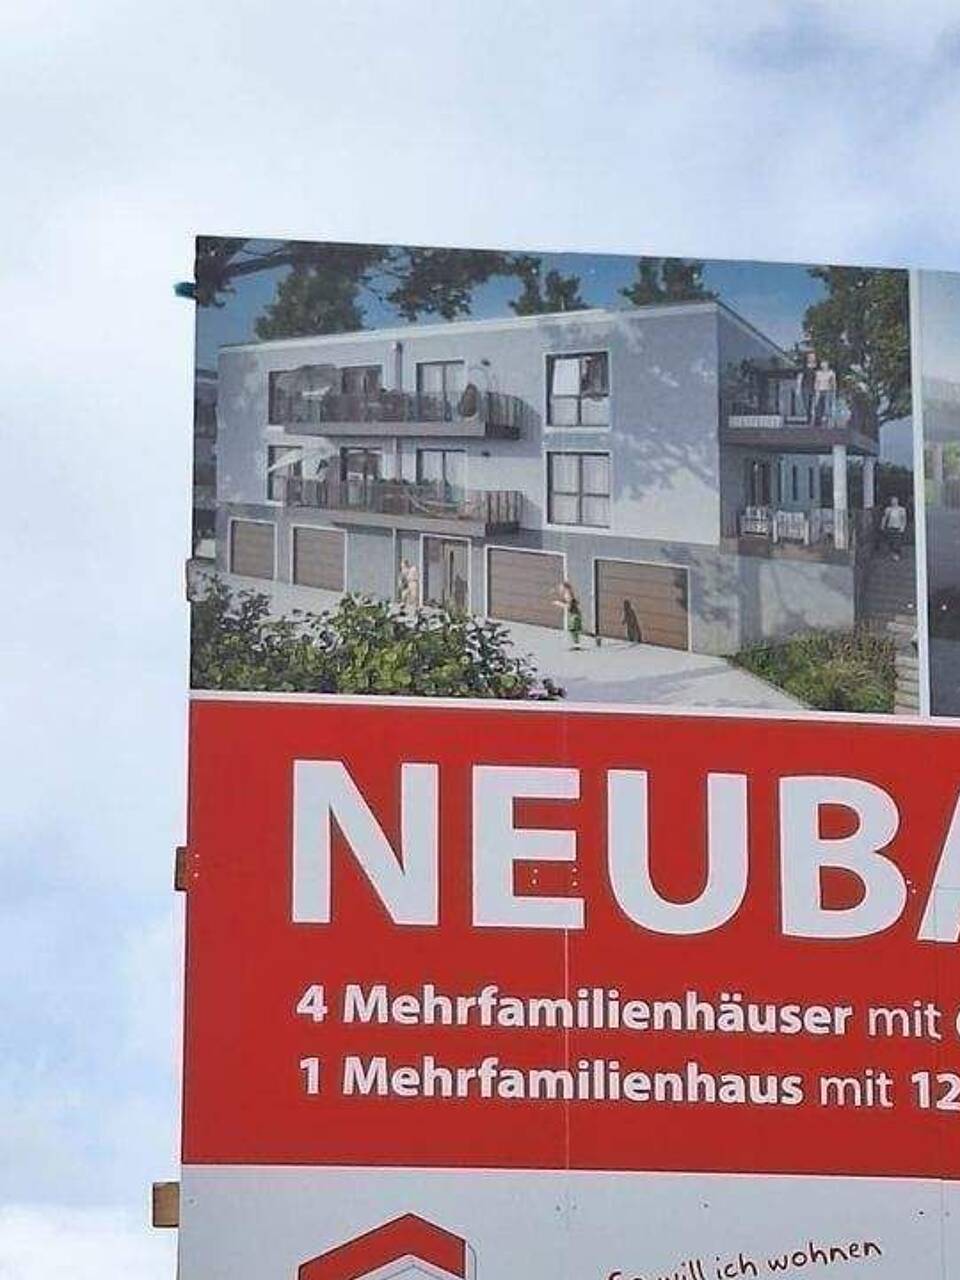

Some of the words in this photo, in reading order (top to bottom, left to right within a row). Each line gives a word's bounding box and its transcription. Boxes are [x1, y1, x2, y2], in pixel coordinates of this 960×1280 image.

[296, 985, 328, 1022] 4
[343, 984, 851, 1036] Mehrfamilienhäuser
[868, 1002, 942, 1039] mit
[301, 1058, 321, 1094] 1
[342, 1056, 803, 1106] Mehrfamilienhaus
[820, 1071, 894, 1109] mit
[715, 1252, 758, 1280] ich
[767, 1238, 882, 1273] wohnen
